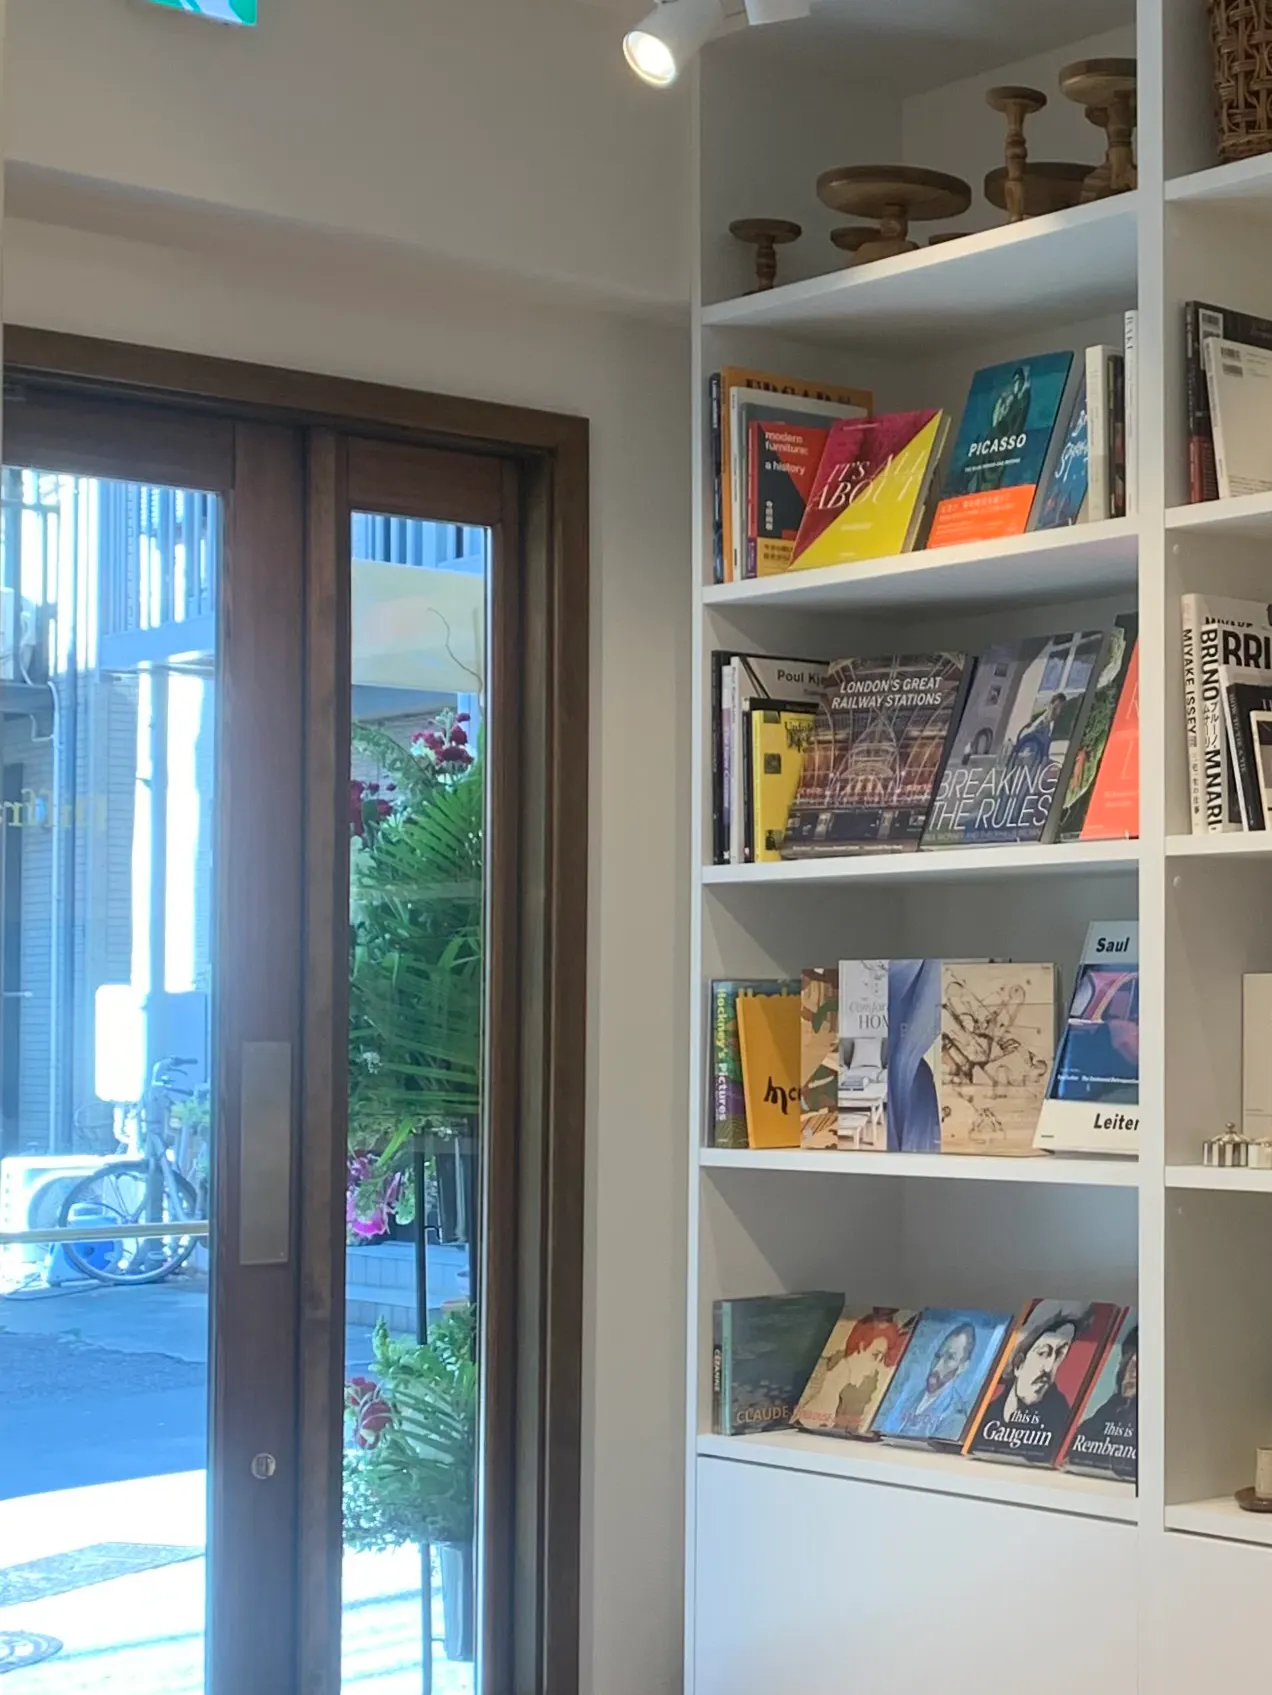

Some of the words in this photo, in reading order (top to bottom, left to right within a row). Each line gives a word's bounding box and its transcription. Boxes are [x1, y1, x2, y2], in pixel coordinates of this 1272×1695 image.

[765, 431, 803, 443] modern
[968, 433, 1027, 457] PICASSO
[765, 461, 772, 470] a
[773, 460, 805, 476] history
[806, 475, 915, 512] ABOUT
[1183, 628, 1195, 686] MIYAKE
[777, 669, 804, 683] Poul
[840, 678, 899, 694] LONDON'S
[903, 676, 943, 692] GREAT
[831, 695, 884, 709] RAILWAY
[885, 692, 942, 707] STATIONS
[1186, 690, 1197, 735] ISSEY
[935, 762, 1062, 801] BREAKING
[929, 799, 974, 830] THE
[974, 795, 1052, 828] RULES
[1095, 936, 1129, 954] Saul
[849, 1001, 888, 1015] Comfor
[716, 988, 727, 1059] Hockney's
[716, 1062, 729, 1121] Pictures
[1093, 1113, 1139, 1131] Leiter
[736, 1405, 789, 1424] CLAUDE
[1010, 1410, 1030, 1424] This
[1031, 1413, 1040, 1424] is
[983, 1420, 1052, 1447] Gauguin
[1103, 1421, 1123, 1436] This
[1123, 1424, 1133, 1437] is
